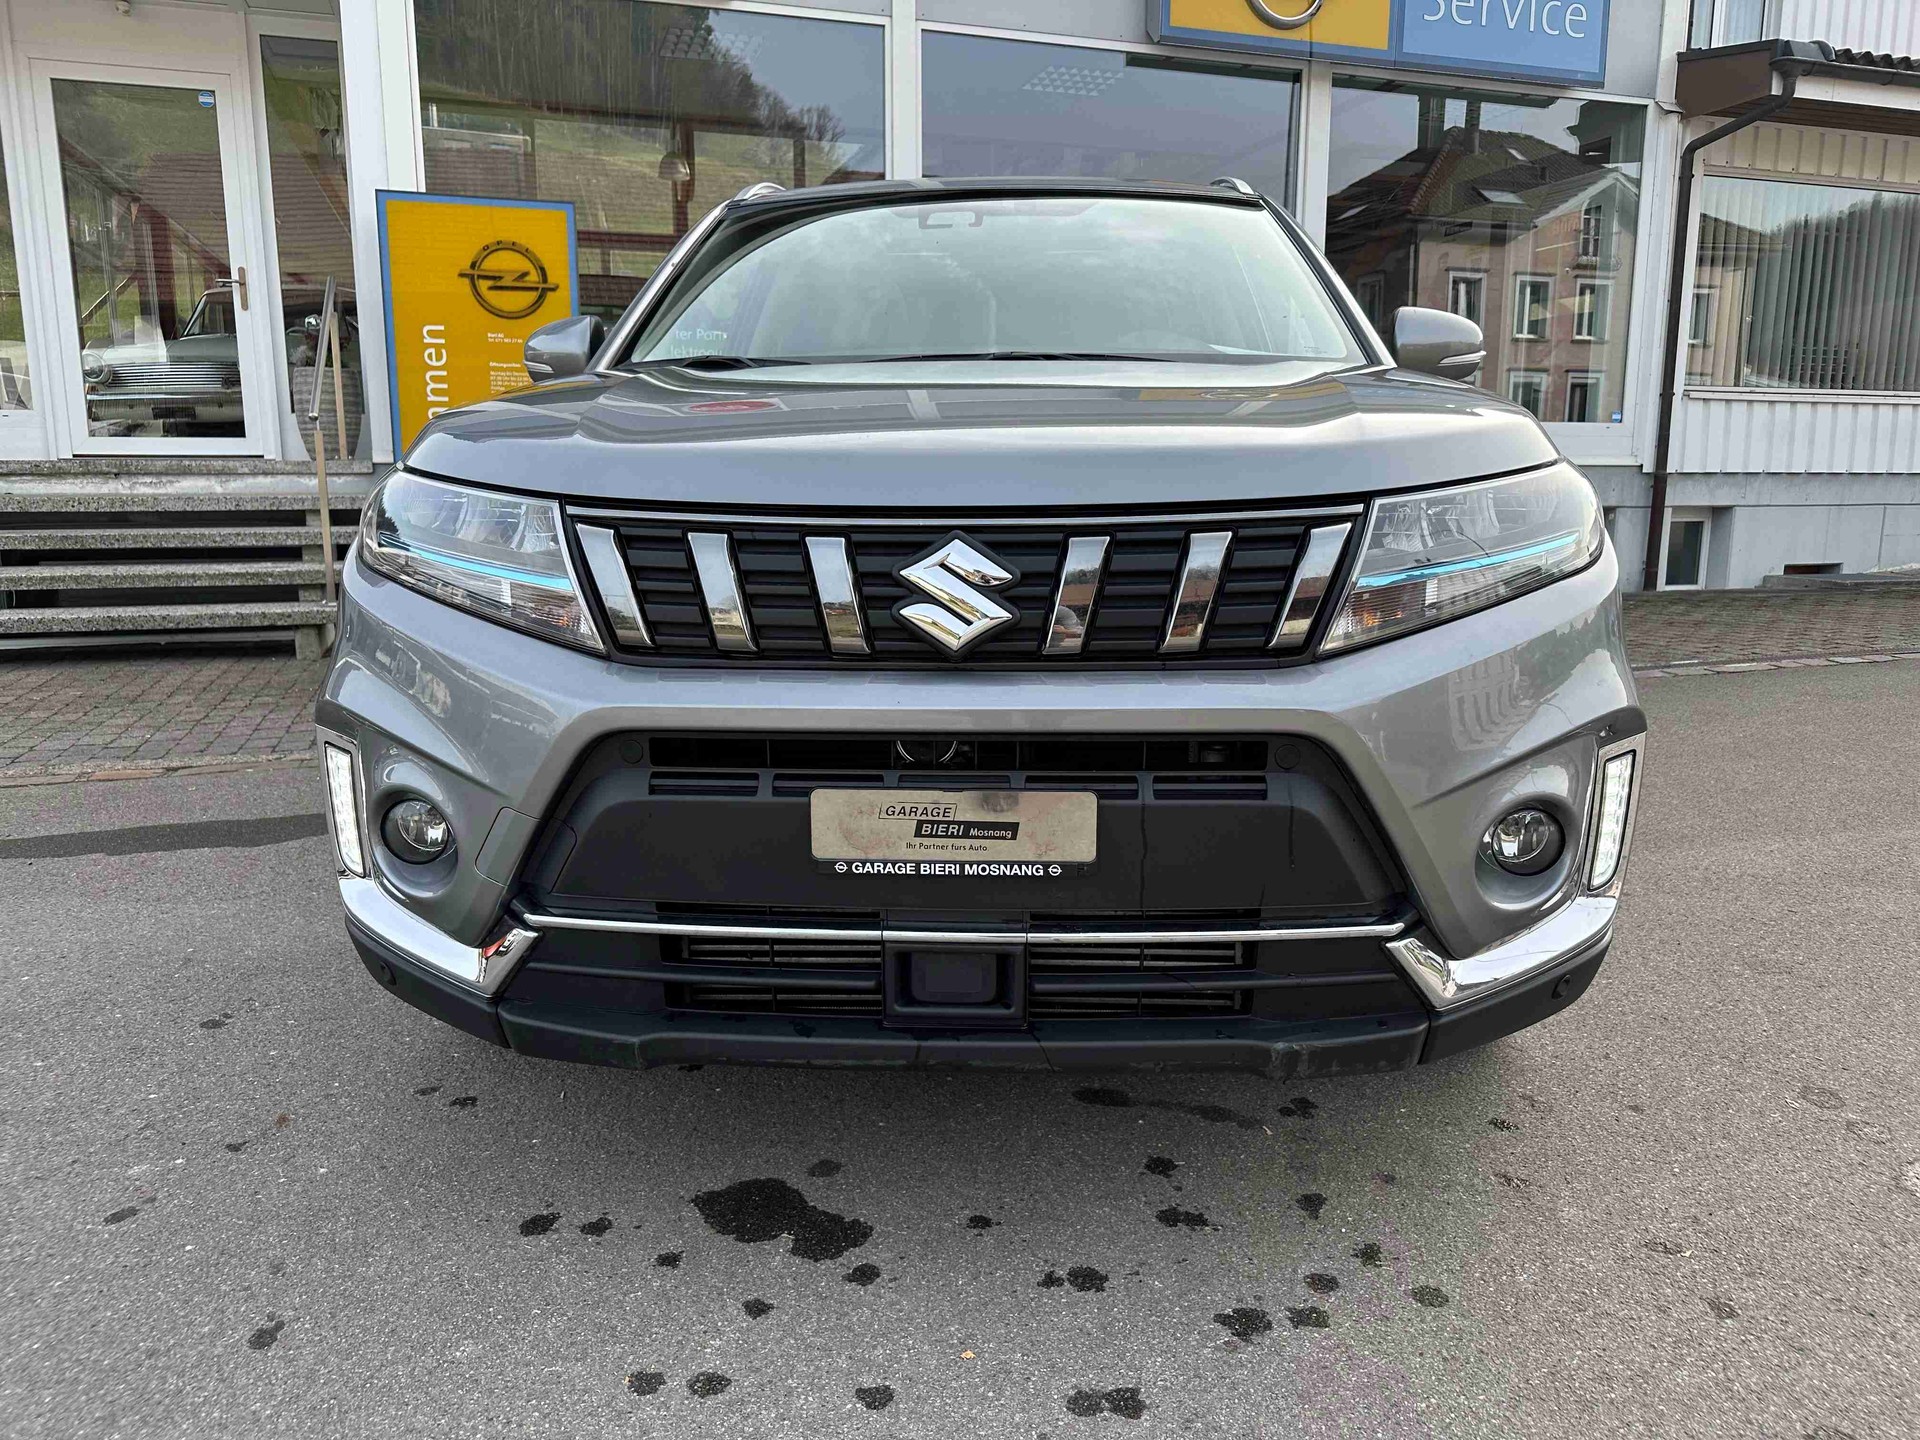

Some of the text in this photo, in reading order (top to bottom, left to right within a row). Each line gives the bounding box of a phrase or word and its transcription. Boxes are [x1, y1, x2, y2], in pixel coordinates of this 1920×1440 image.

[885, 805, 952, 818] GARAGE
[921, 823, 1012, 839] BIERI Mosnang
[919, 843, 949, 851] Partner
[852, 862, 1044, 876] GARAGE BIERI MOSNANG
